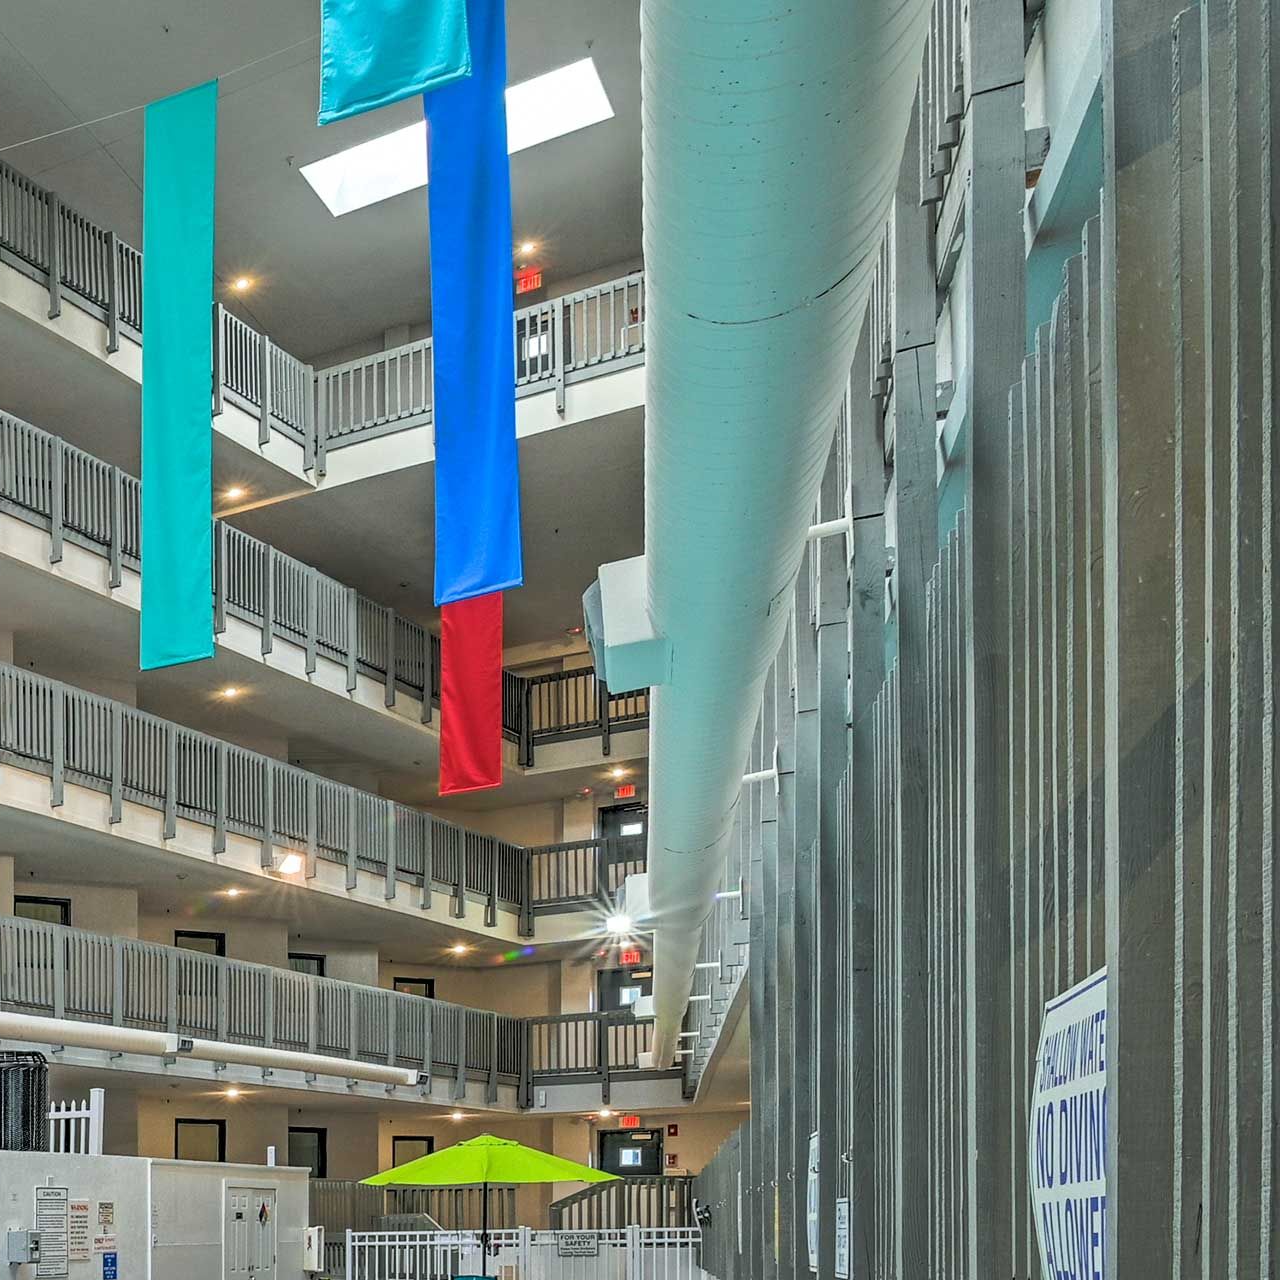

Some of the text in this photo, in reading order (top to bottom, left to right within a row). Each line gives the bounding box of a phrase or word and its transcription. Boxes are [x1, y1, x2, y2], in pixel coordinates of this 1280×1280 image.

[1040, 1009, 1106, 1093] SHALLOW WATE
[1037, 1101, 1053, 1189] NO
